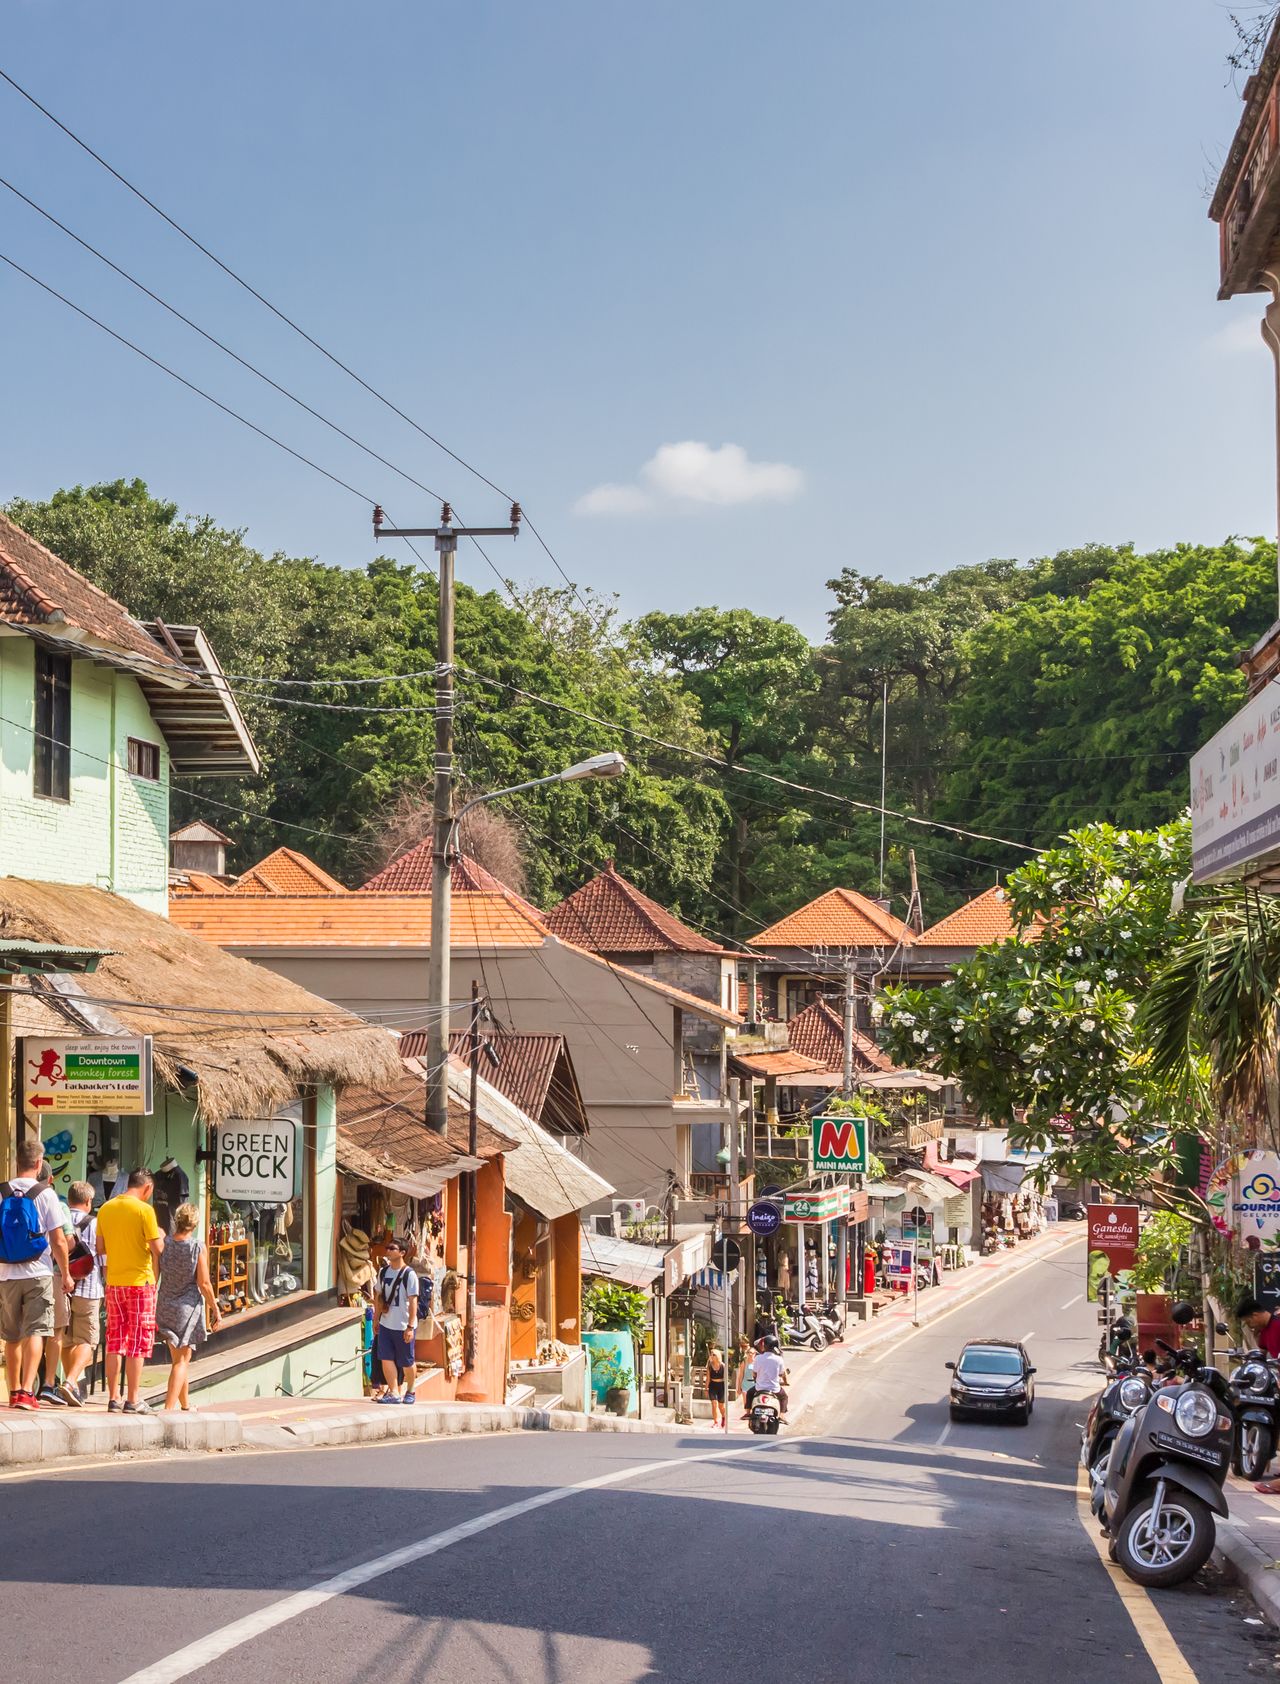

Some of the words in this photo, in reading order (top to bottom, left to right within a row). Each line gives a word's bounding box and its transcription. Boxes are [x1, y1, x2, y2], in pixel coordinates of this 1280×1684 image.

[79, 1056, 126, 1065] Downtown
[70, 1068, 105, 1079] monkey
[108, 1067, 134, 1077] forest
[65, 1083, 115, 1091] Backpacker's
[117, 1083, 139, 1091] Lodge
[222, 1133, 288, 1153] GREEN
[221, 1153, 288, 1179] ROCK
[815, 1161, 836, 1169] MINI
[837, 1163, 863, 1171] MART
[796, 1202, 808, 1211] 24
[1092, 1223, 1133, 1235] Ganesha
